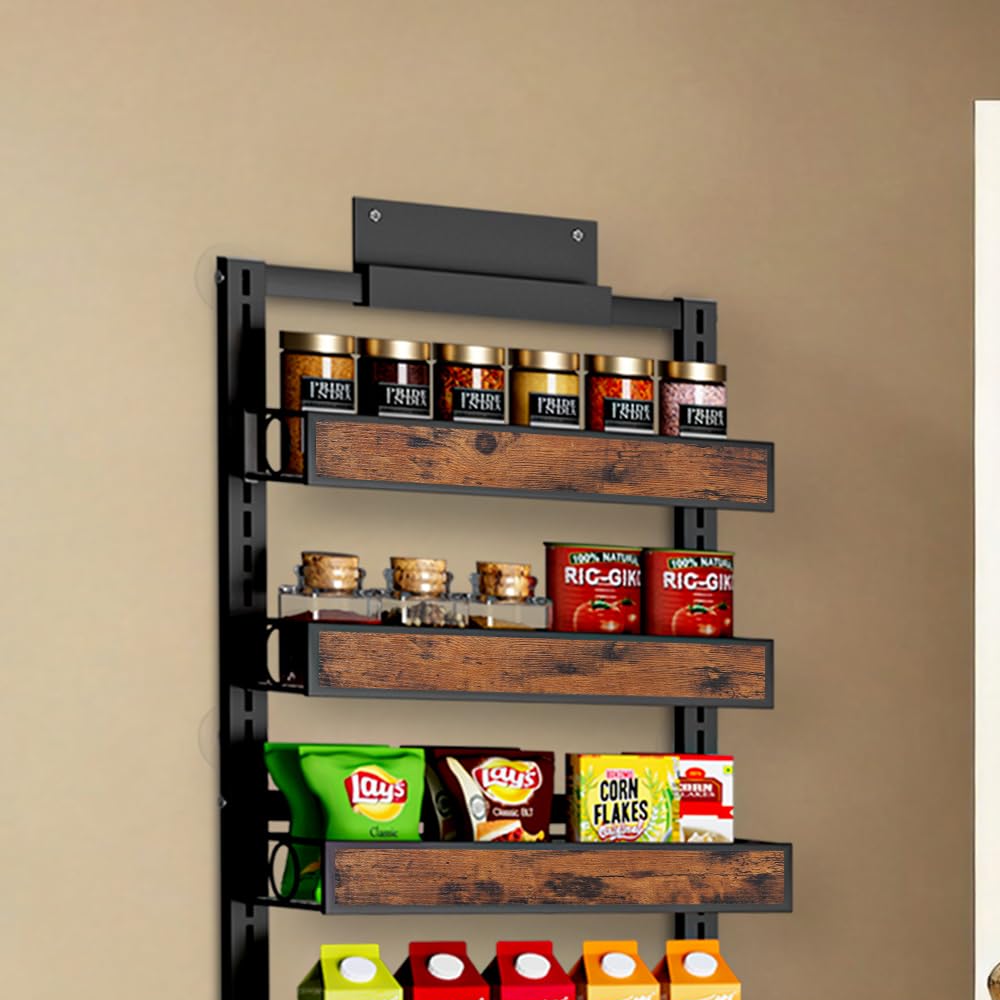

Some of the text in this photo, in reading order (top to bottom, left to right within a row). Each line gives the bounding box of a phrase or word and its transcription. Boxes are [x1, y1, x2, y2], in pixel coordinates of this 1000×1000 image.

[572, 553, 600, 565] 100%
[663, 571, 733, 591] RIC-GIK
[600, 777, 639, 802] CORN
[594, 799, 648, 825] FLAKES
